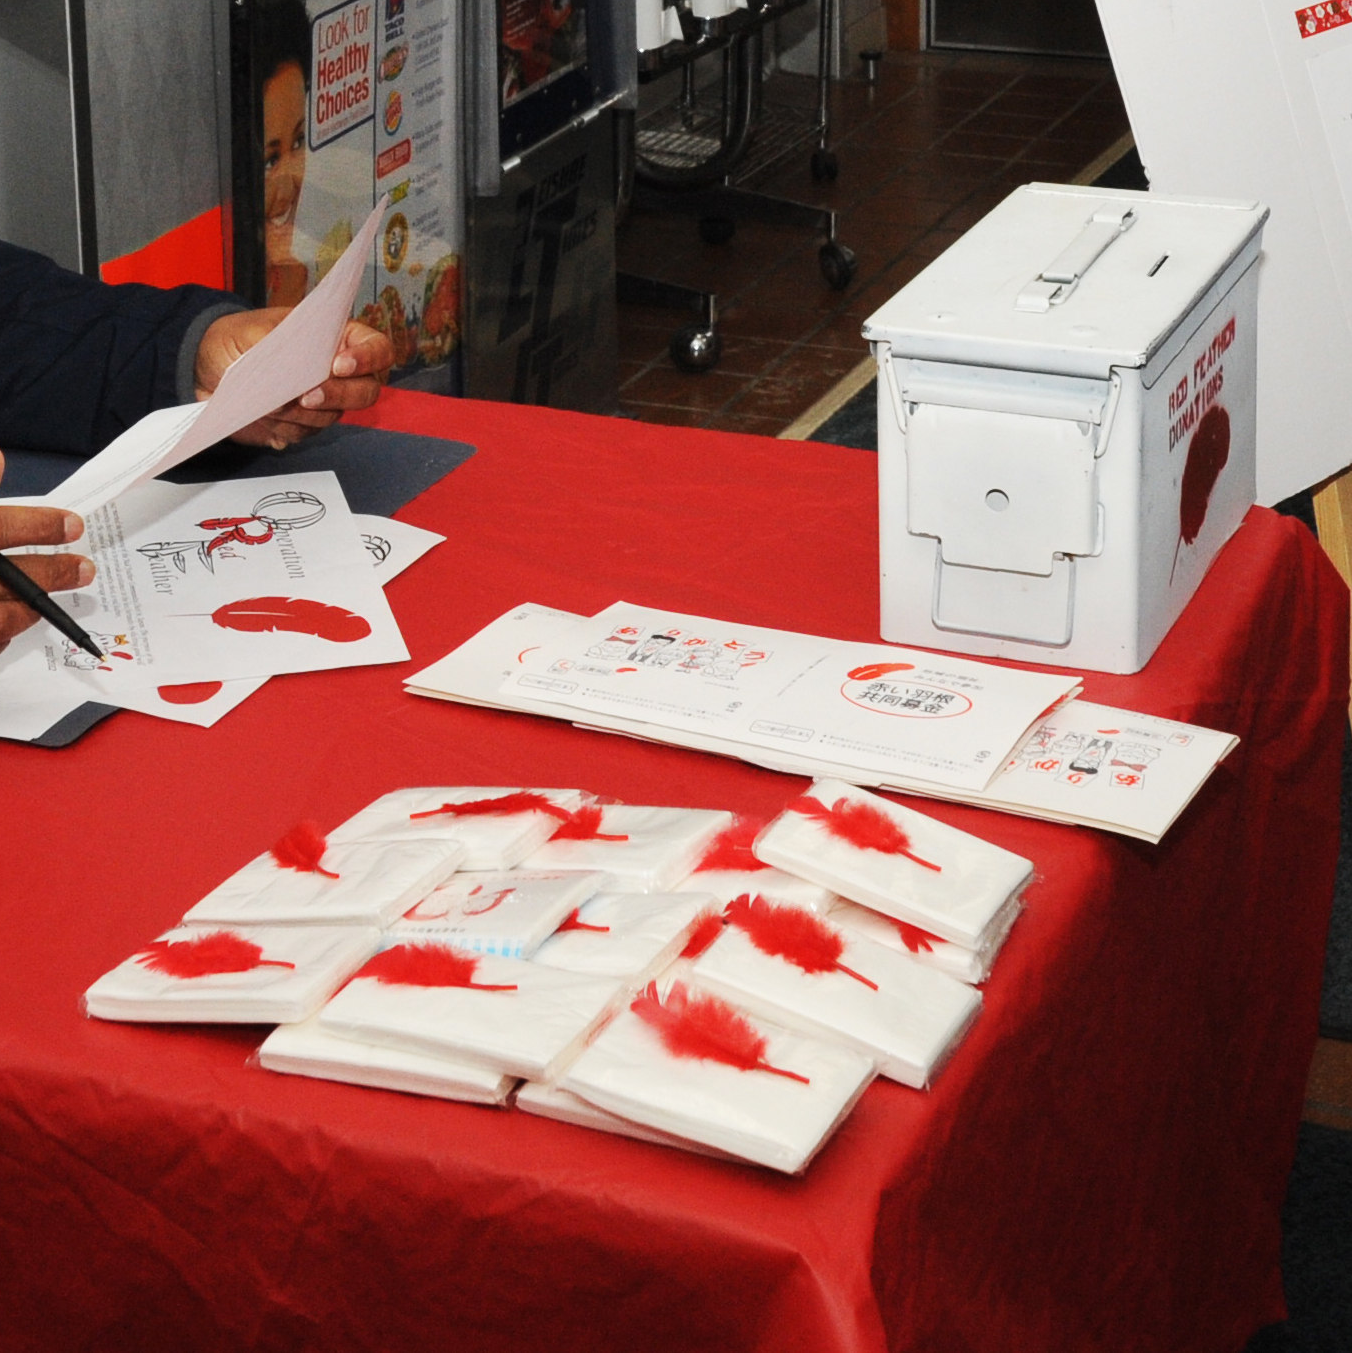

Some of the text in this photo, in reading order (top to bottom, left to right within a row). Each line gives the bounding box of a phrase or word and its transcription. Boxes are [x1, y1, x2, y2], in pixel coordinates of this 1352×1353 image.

[318, 4, 371, 54] Look for
[385, 17, 405, 34] TACO
[385, 28, 405, 43] BELL
[317, 41, 370, 91] Healthy
[316, 76, 370, 124] Choices
[1168, 315, 1237, 417] RED FEATHER
[1168, 364, 1225, 454] DONATIONS
[856, 689, 946, 715] 共同募金
[866, 681, 956, 706] 赤い羽根
